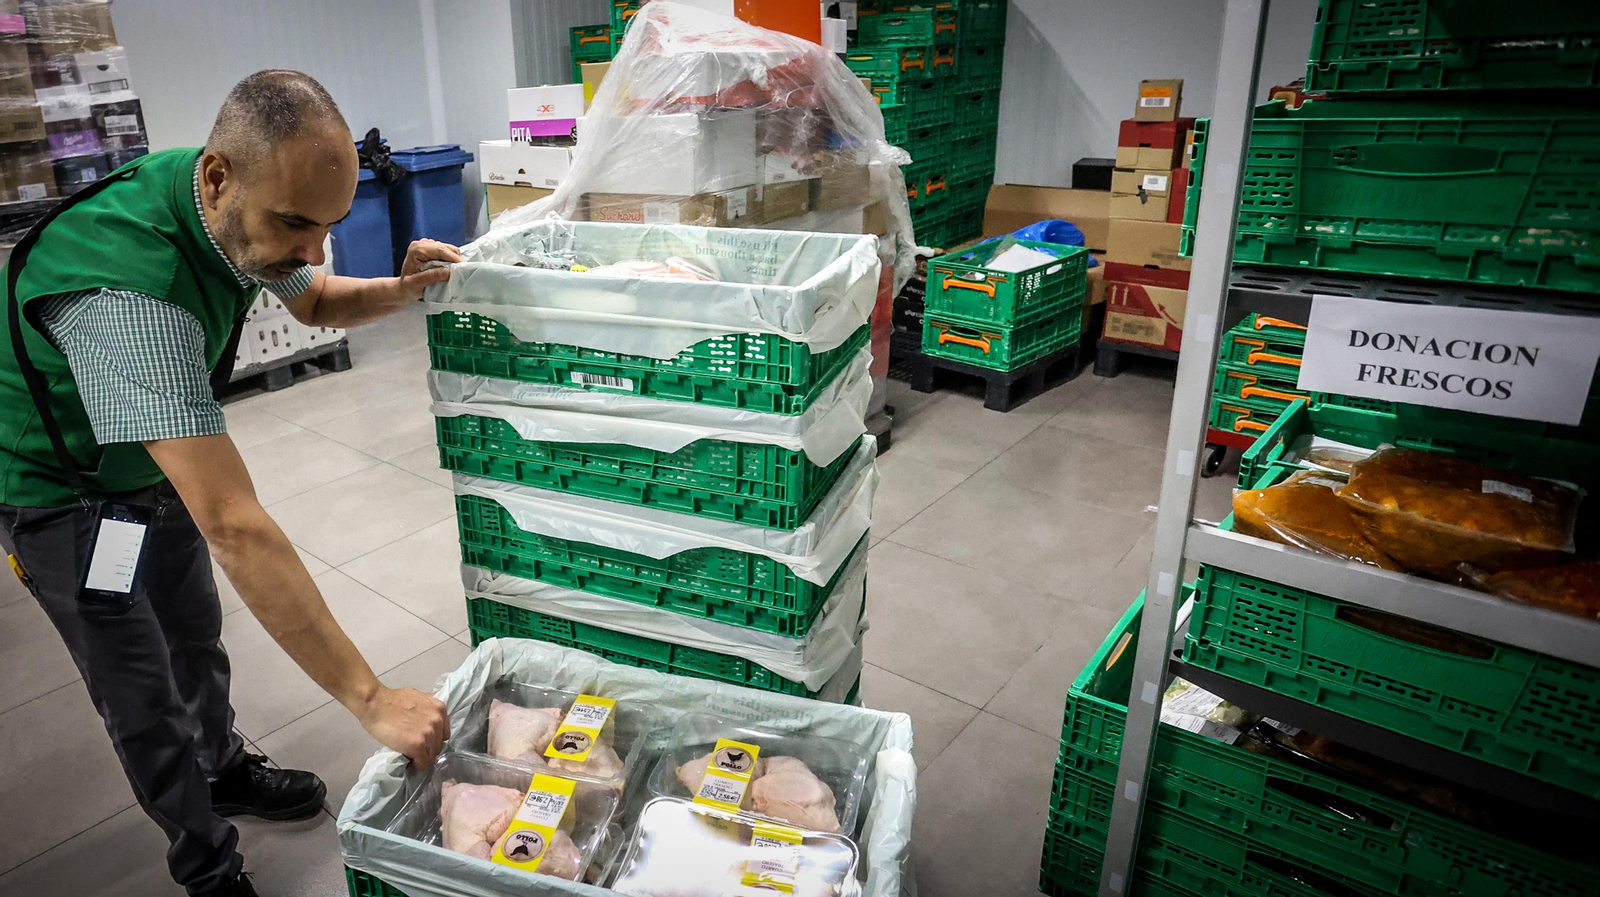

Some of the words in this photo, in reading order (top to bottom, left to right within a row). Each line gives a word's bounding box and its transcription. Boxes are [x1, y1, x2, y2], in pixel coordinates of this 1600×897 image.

[511, 127, 532, 142] PITA
[1348, 328, 1541, 367] DONACION
[1355, 363, 1514, 400] FRESCOS
[720, 761, 742, 769] POLLO
[515, 834, 539, 844] POLLO
